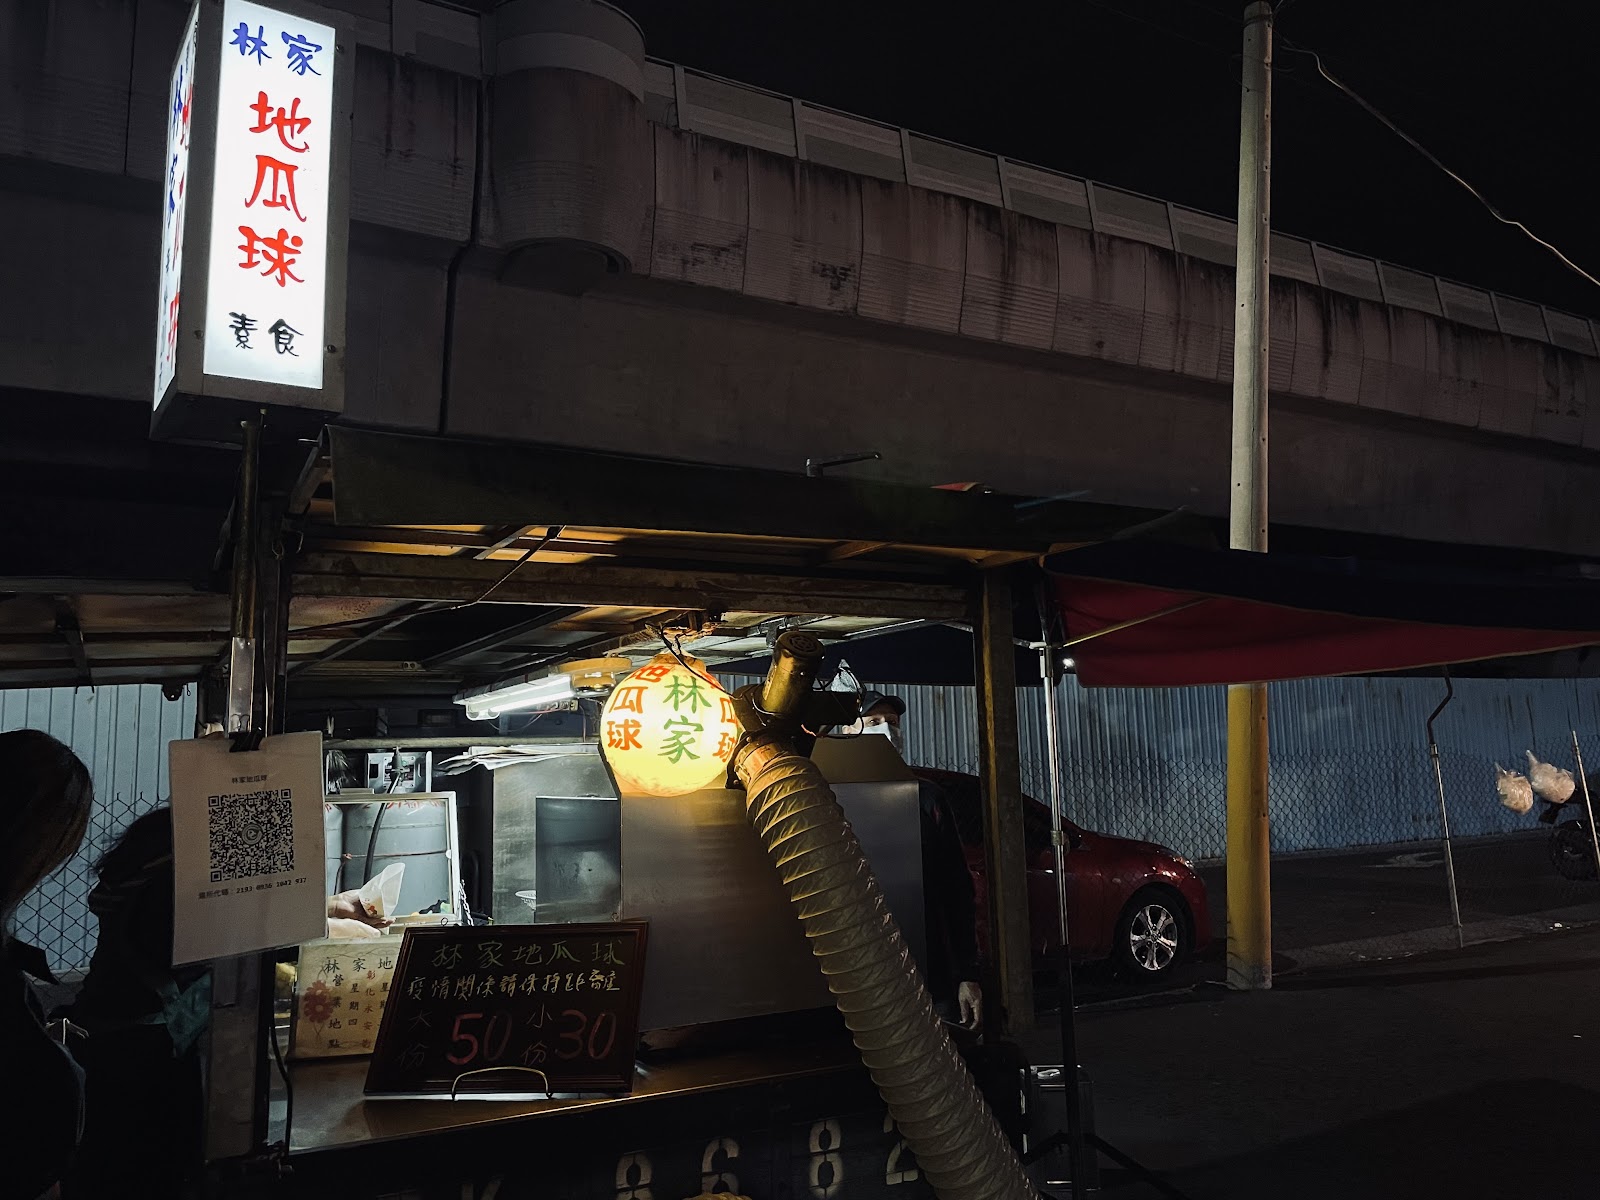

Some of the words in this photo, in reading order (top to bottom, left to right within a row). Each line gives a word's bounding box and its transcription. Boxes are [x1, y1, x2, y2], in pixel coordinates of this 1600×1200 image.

[229, 21, 323, 77] 林家
[238, 90, 312, 288] 地瓜球
[229, 311, 304, 357] 素食
[657, 674, 712, 765] 林家
[431, 938, 625, 970] 林家地瓜球
[347, 982, 360, 1026] 星期四
[445, 1009, 513, 1066] 50
[554, 1008, 617, 1060] 30
